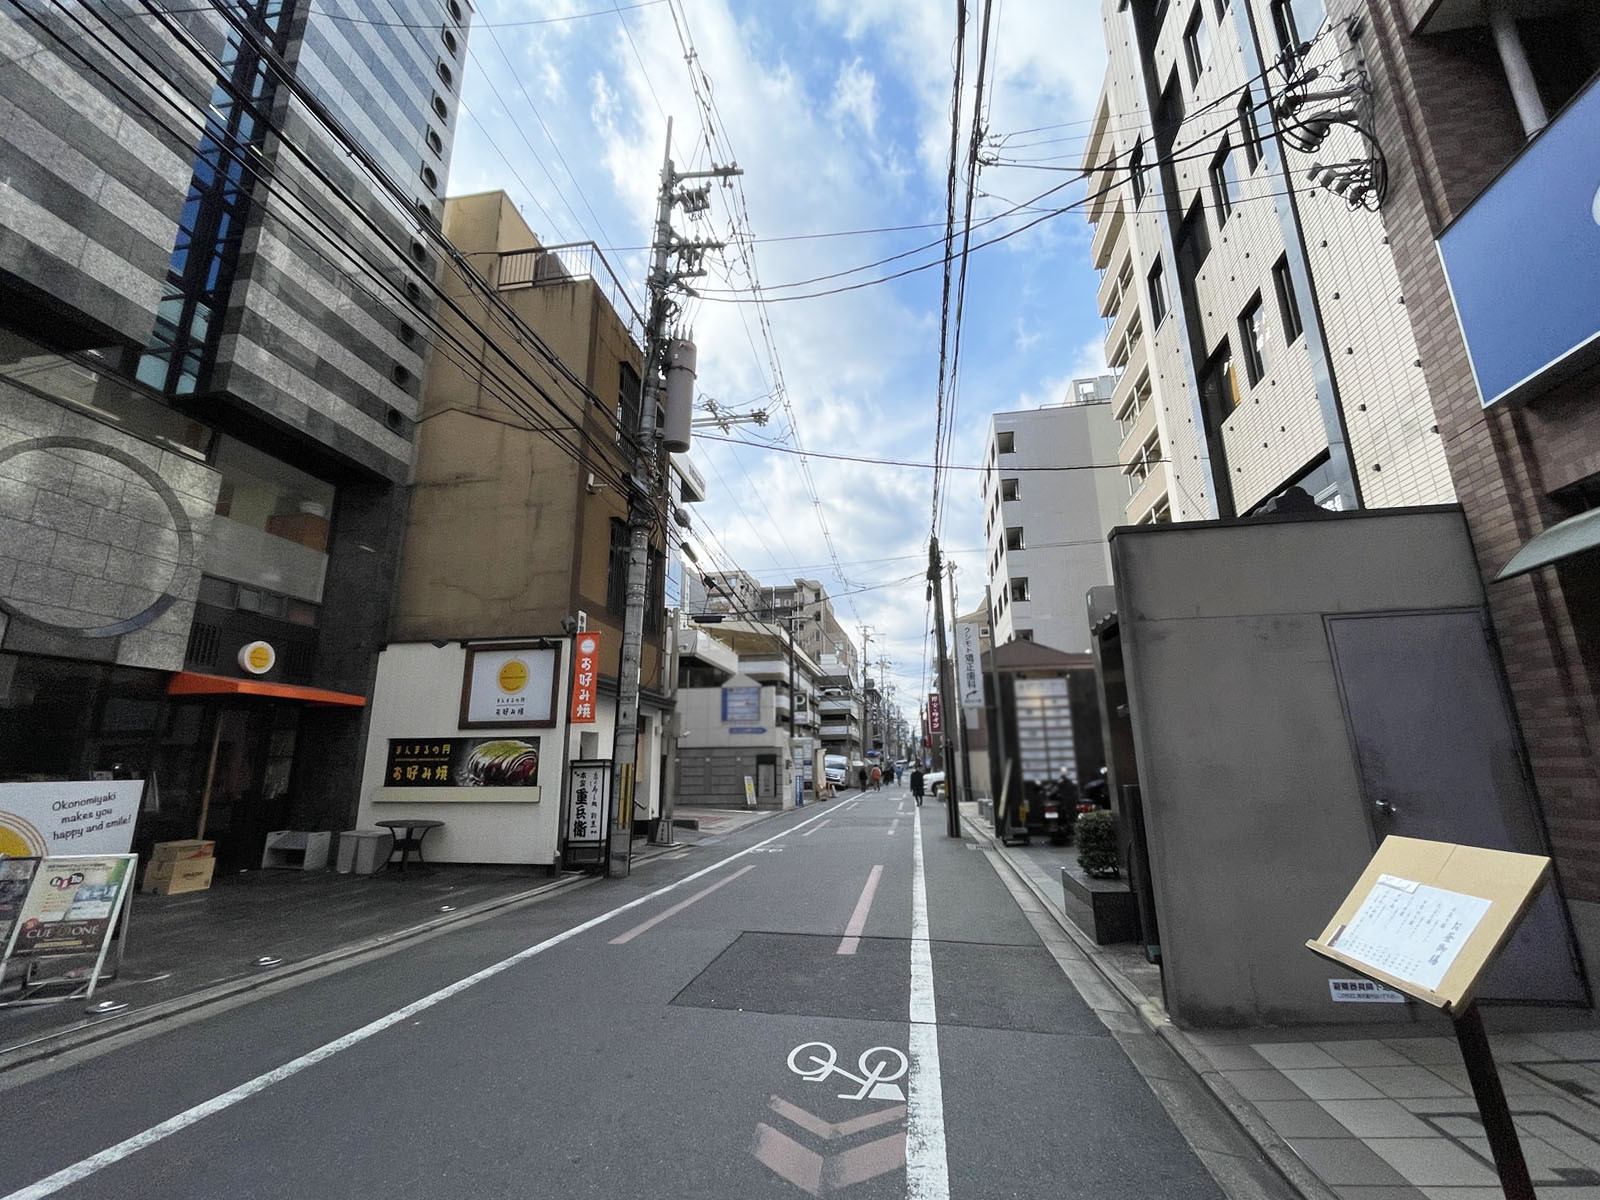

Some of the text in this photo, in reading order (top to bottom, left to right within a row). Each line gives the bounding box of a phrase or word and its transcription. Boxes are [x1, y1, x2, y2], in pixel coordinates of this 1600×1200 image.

[577, 657, 592, 718] お好み焼
[794, 694, 805, 709] P
[393, 764, 449, 781] お好み焼
[52, 792, 117, 811] Okonomiyaki
[61, 808, 113, 824] makes you
[53, 814, 132, 840] happy and smile!
[71, 925, 100, 936] ONE
